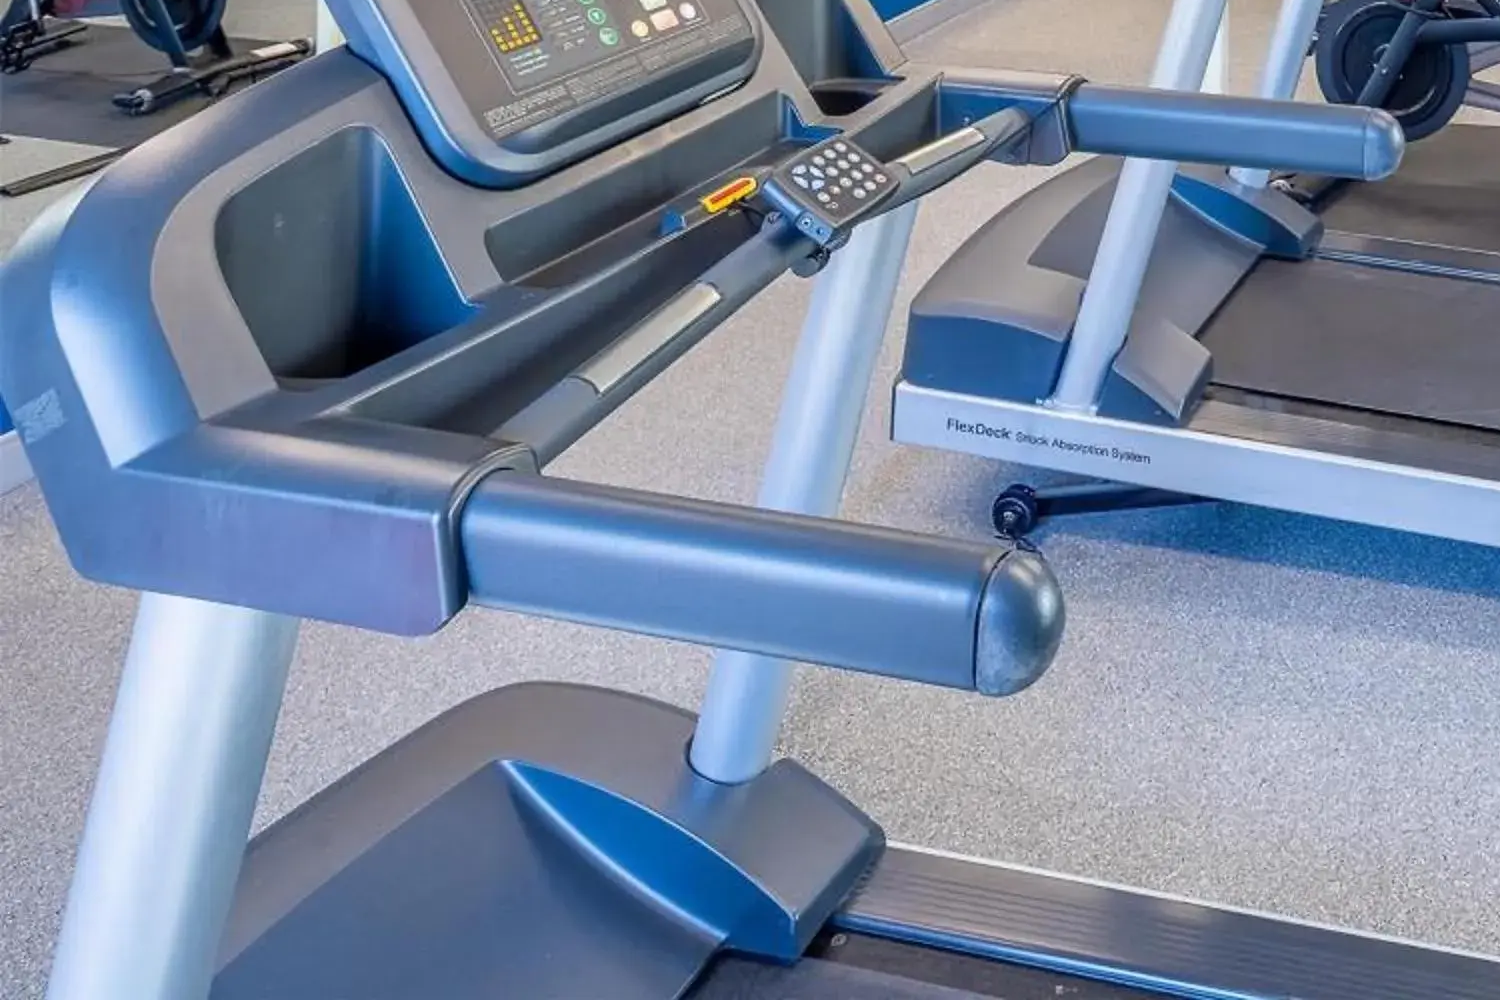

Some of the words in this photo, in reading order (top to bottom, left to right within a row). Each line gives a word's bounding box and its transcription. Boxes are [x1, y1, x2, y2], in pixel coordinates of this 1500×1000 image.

[946, 417, 1013, 441] FlexDeck
[1051, 435, 1109, 458] Absorption
[1111, 447, 1152, 465] System
